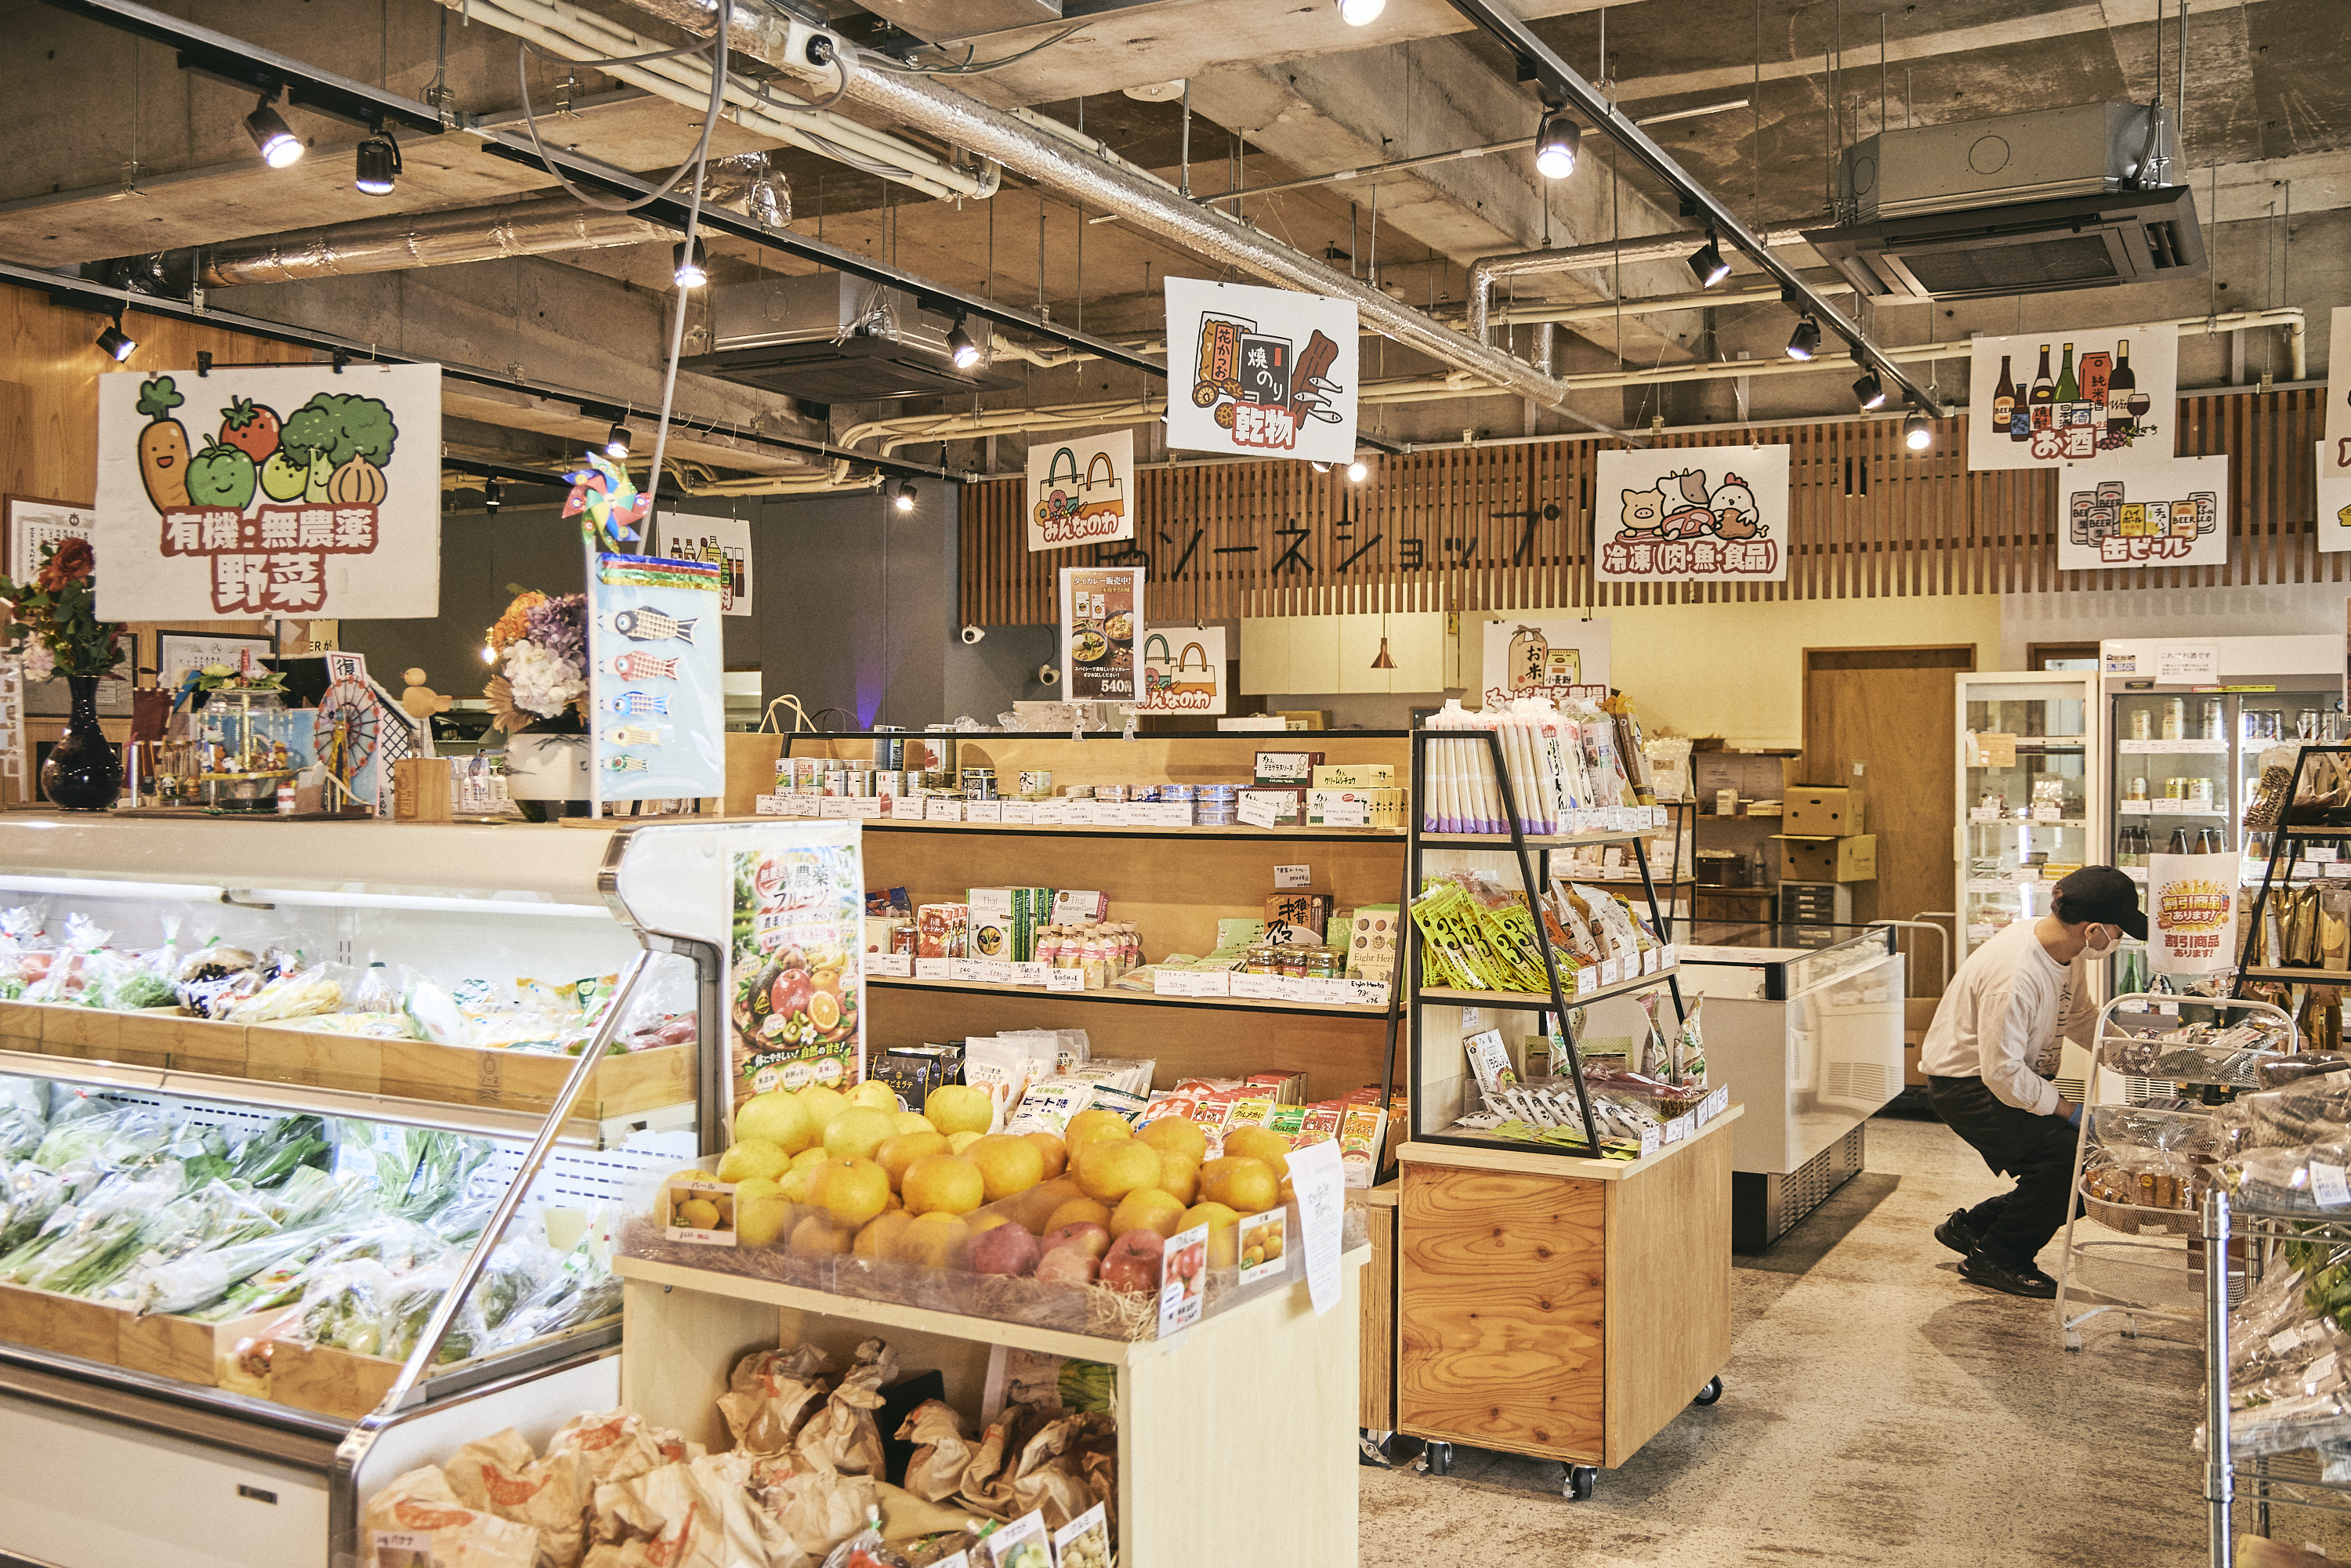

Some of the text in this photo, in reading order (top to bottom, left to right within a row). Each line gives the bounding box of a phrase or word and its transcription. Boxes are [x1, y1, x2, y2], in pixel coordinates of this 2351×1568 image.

[1217, 328, 1232, 379] 花かつお
[1247, 346, 1283, 402] 焼のり
[2090, 375, 2107, 411] 純米酒
[2110, 398, 2128, 411] Win
[1235, 404, 1295, 447] 乾物
[2034, 427, 2094, 457] お酒
[2099, 498, 2121, 507] BEER
[1043, 511, 1119, 541] みんなのわ
[2088, 519, 2112, 528] BEER
[2172, 516, 2196, 525] BEER
[163, 508, 376, 552] 有機・無農薬
[1605, 541, 1777, 572] 冷凍(肉・魚・食品)
[2102, 536, 2190, 561] 缶ビール
[215, 552, 324, 610] 野菜
[1074, 577, 1132, 586] タイカレー販売中!
[1525, 645, 1542, 681] お米
[1100, 679, 1132, 693] 540円
[1545, 675, 1572, 686] 小麦粉
[773, 889, 830, 914] フルーツ
[982, 896, 998, 905] Thai
[1070, 896, 1086, 905] Thai
[2161, 895, 2222, 911] 割引商品
[991, 905, 1008, 914] Curry
[1081, 905, 1096, 914] Curry
[1294, 897, 1307, 925] 椎茸
[2172, 911, 2216, 922] あります!
[2164, 933, 2220, 948] 割引商品
[1496, 933, 1524, 965] 3
[2173, 948, 2214, 958] あります!
[1353, 952, 1395, 963] Eight Herb
[755, 1048, 799, 1067] 体にやさしい!
[801, 1041, 846, 1059] 自然の甘さ!
[1022, 1096, 1070, 1109] ビート糖
